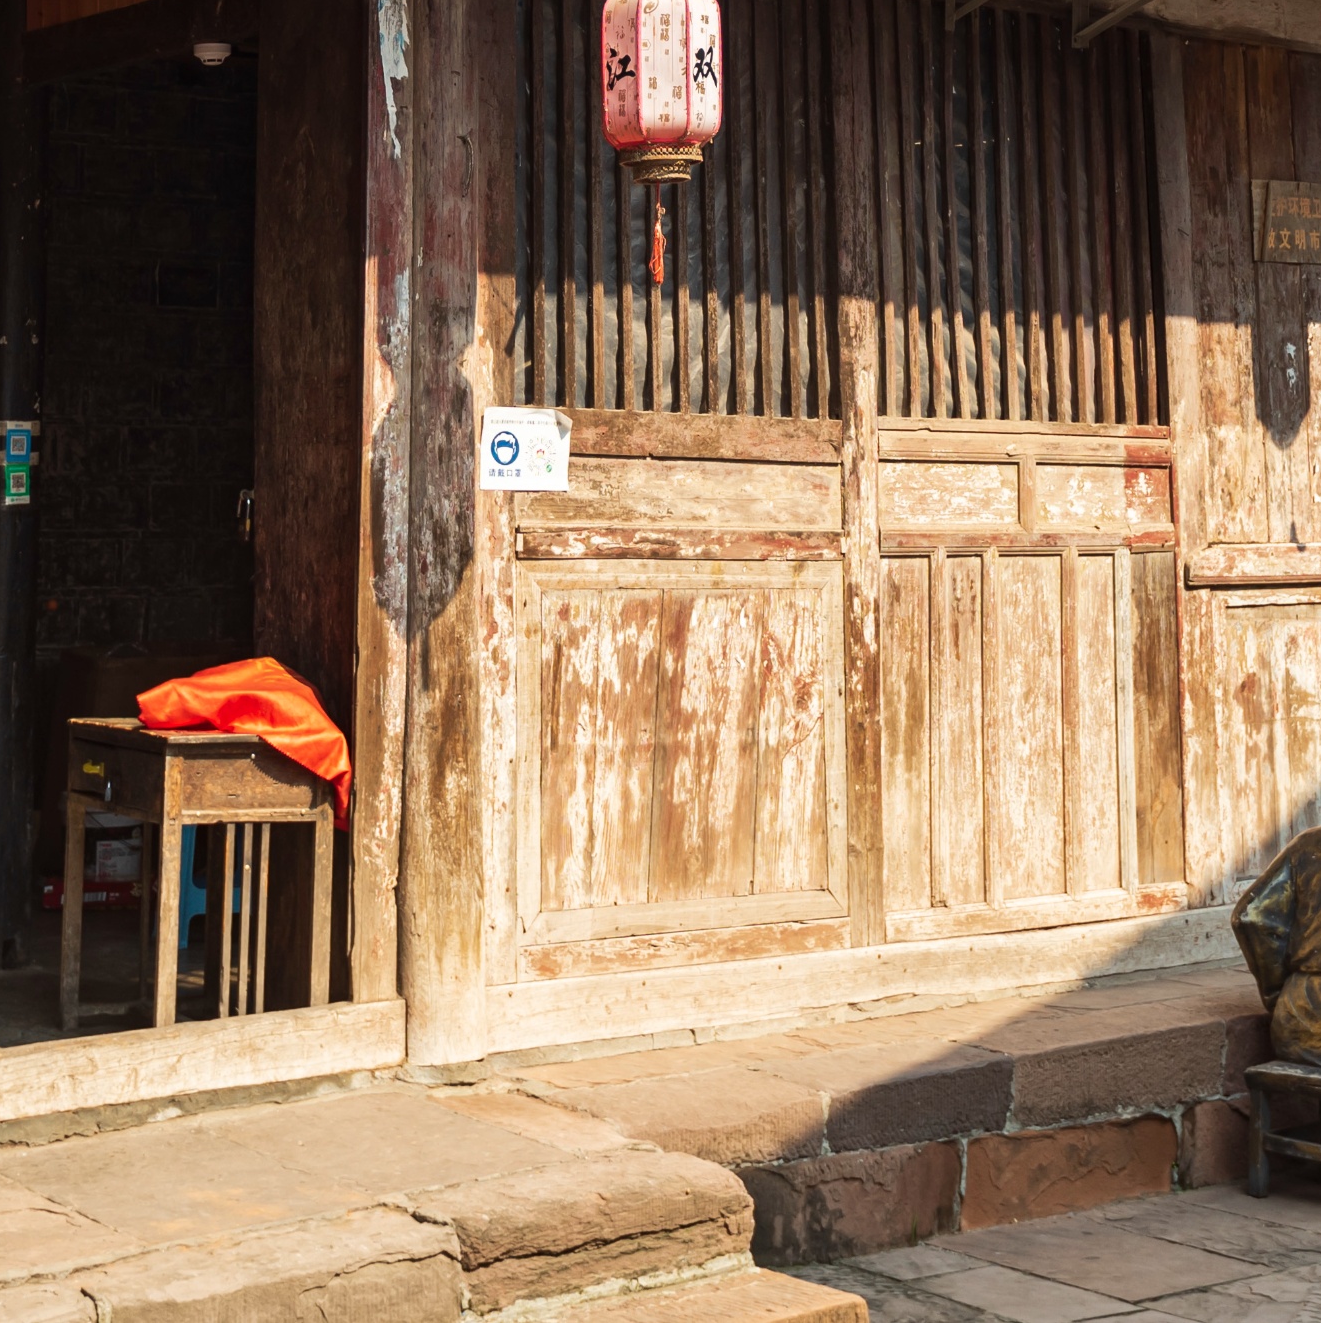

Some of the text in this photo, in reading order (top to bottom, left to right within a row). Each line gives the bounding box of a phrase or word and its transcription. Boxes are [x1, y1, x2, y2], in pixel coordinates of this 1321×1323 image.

[605, 47, 636, 91] 江
[692, 46, 718, 88] 双
[488, 468, 521, 477] 请戴口罩
